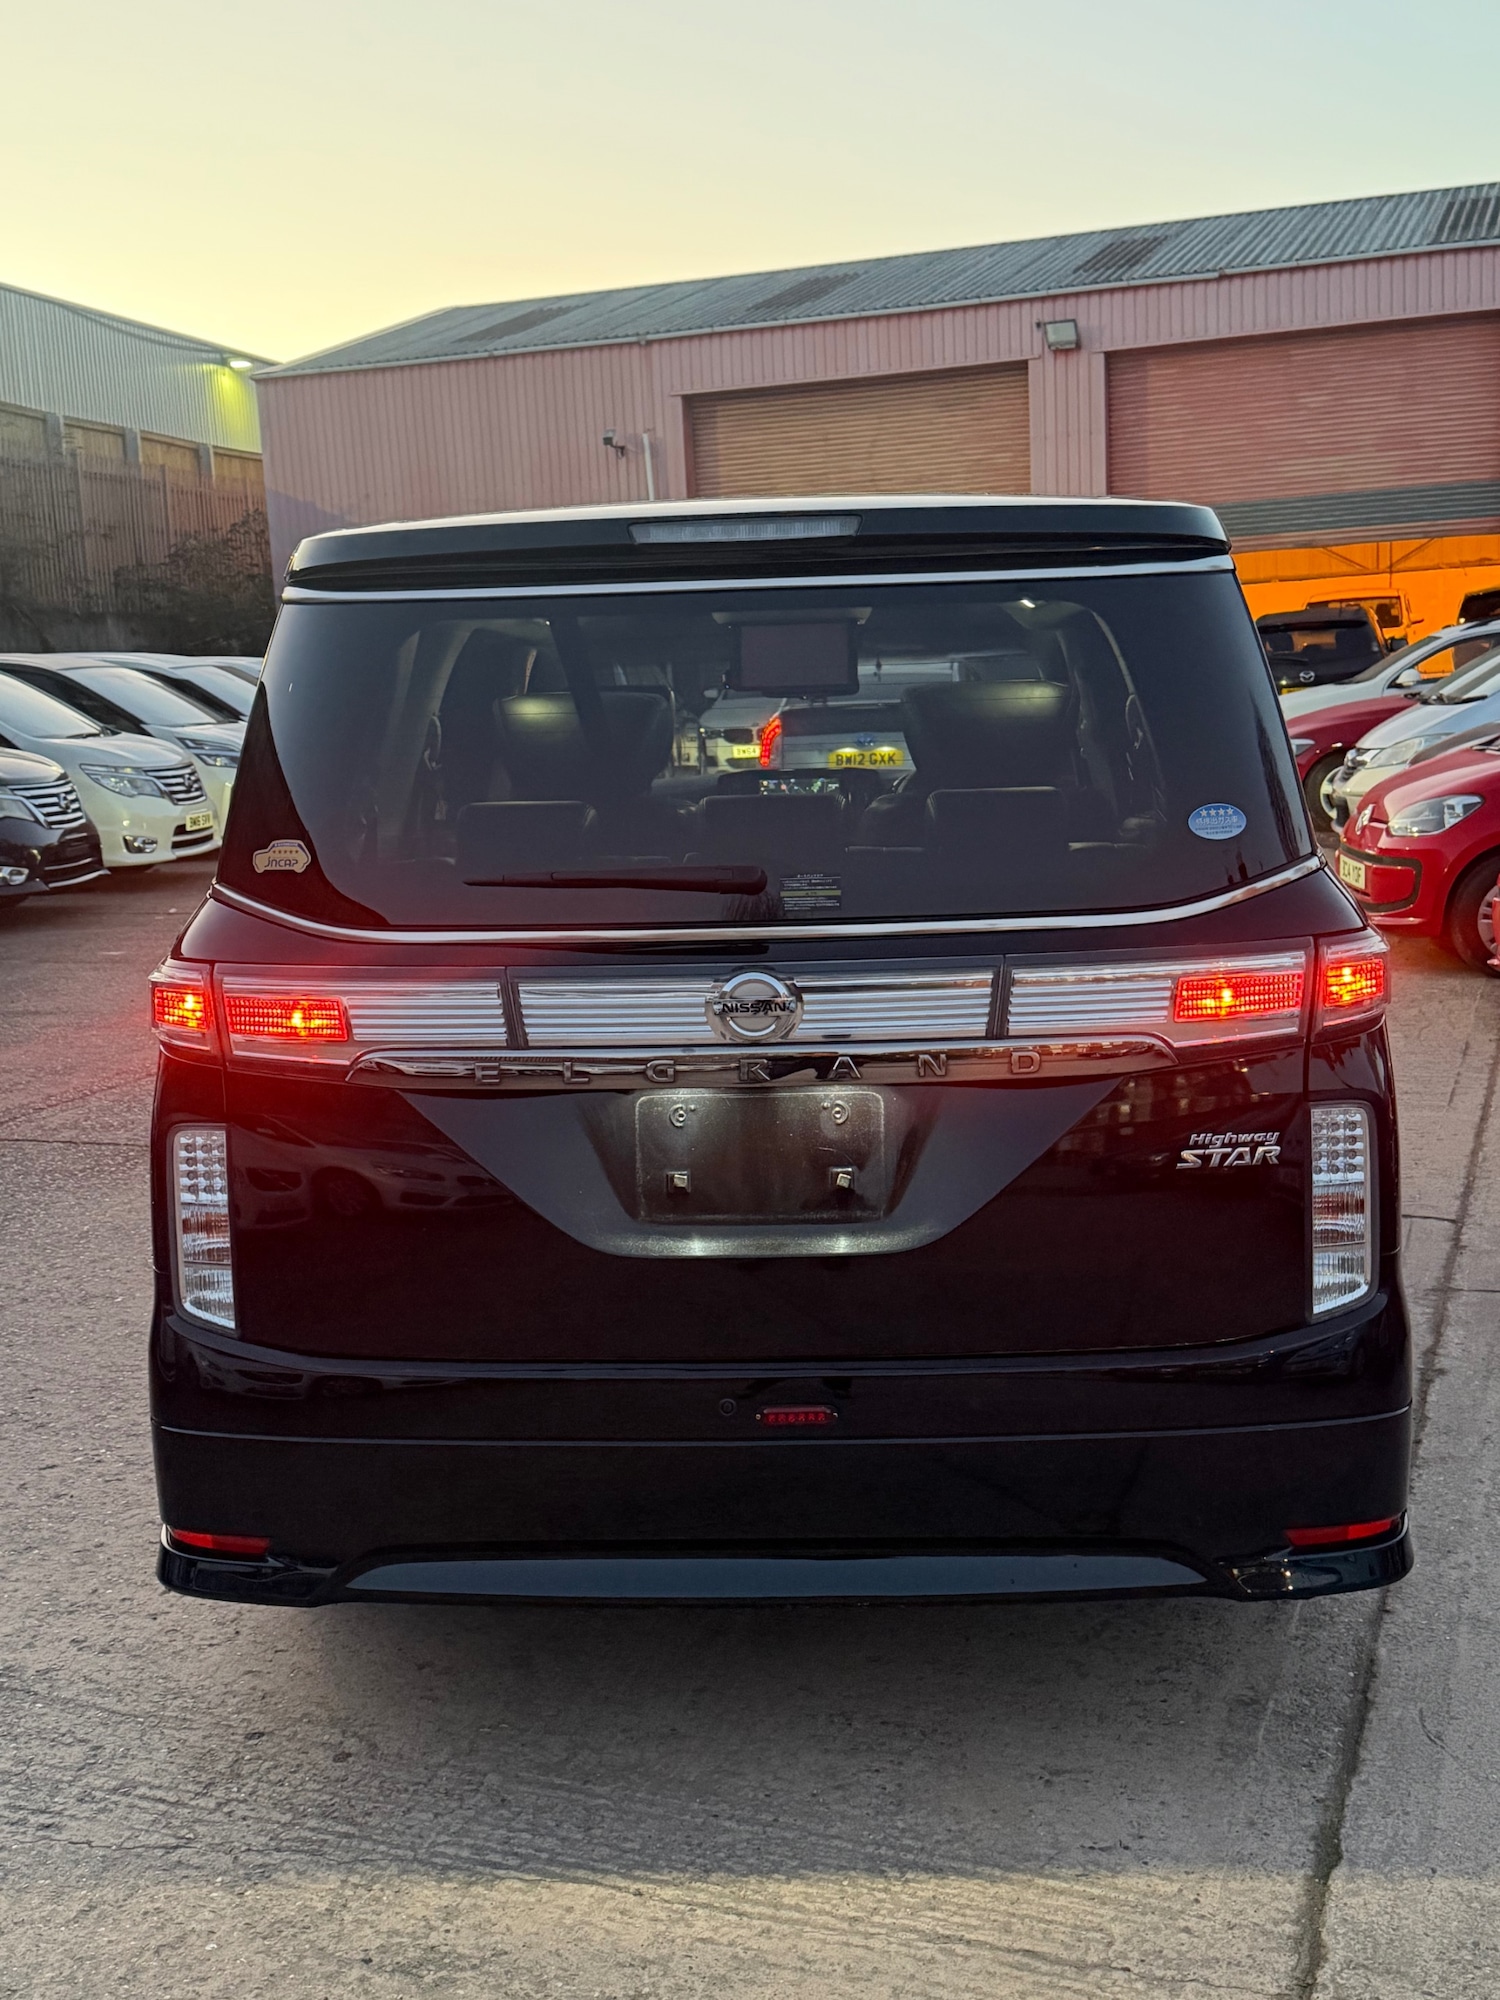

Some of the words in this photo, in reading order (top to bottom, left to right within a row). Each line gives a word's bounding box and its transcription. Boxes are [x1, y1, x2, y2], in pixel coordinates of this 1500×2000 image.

[836, 753, 865, 766] BW12
[869, 752, 896, 765] GXK
[721, 1002, 787, 1014] NISSAN
[1188, 1132, 1280, 1148] Highway
[1176, 1146, 1281, 1169] STAR
